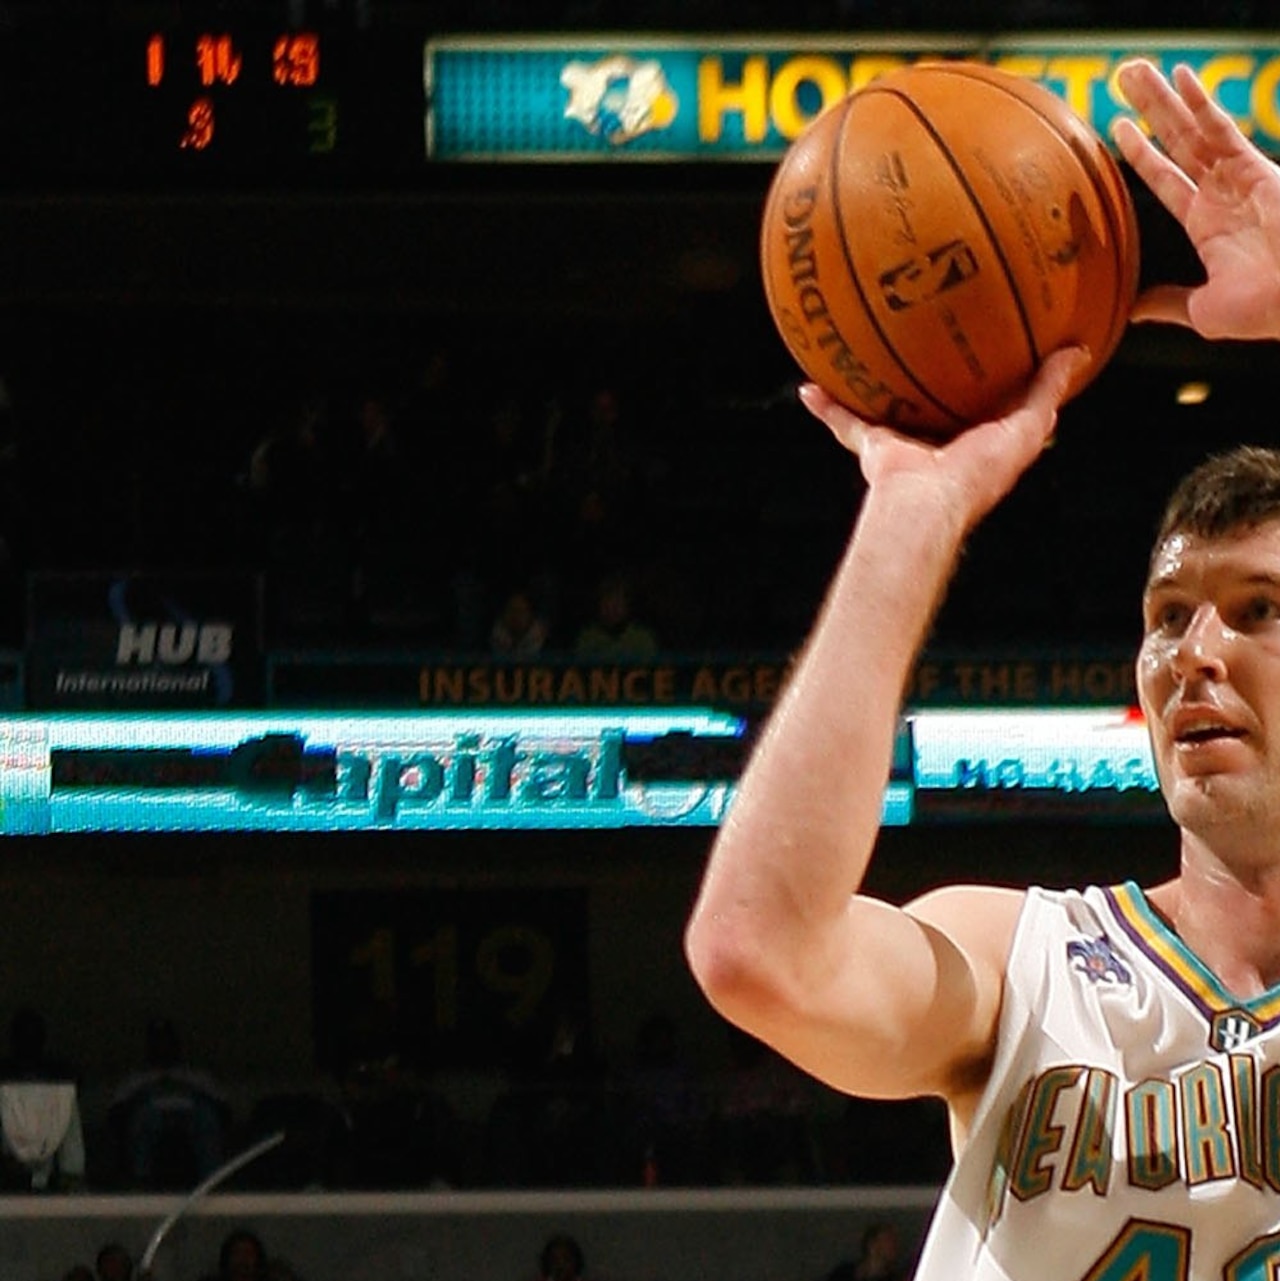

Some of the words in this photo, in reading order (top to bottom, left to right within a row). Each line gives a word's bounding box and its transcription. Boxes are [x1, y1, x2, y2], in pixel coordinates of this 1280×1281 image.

[115, 620, 235, 665] HUB
[55, 669, 209, 695] International
[418, 666, 676, 704] INSURANCE
[955, 661, 1037, 699] THE
[350, 926, 555, 1027] 119
